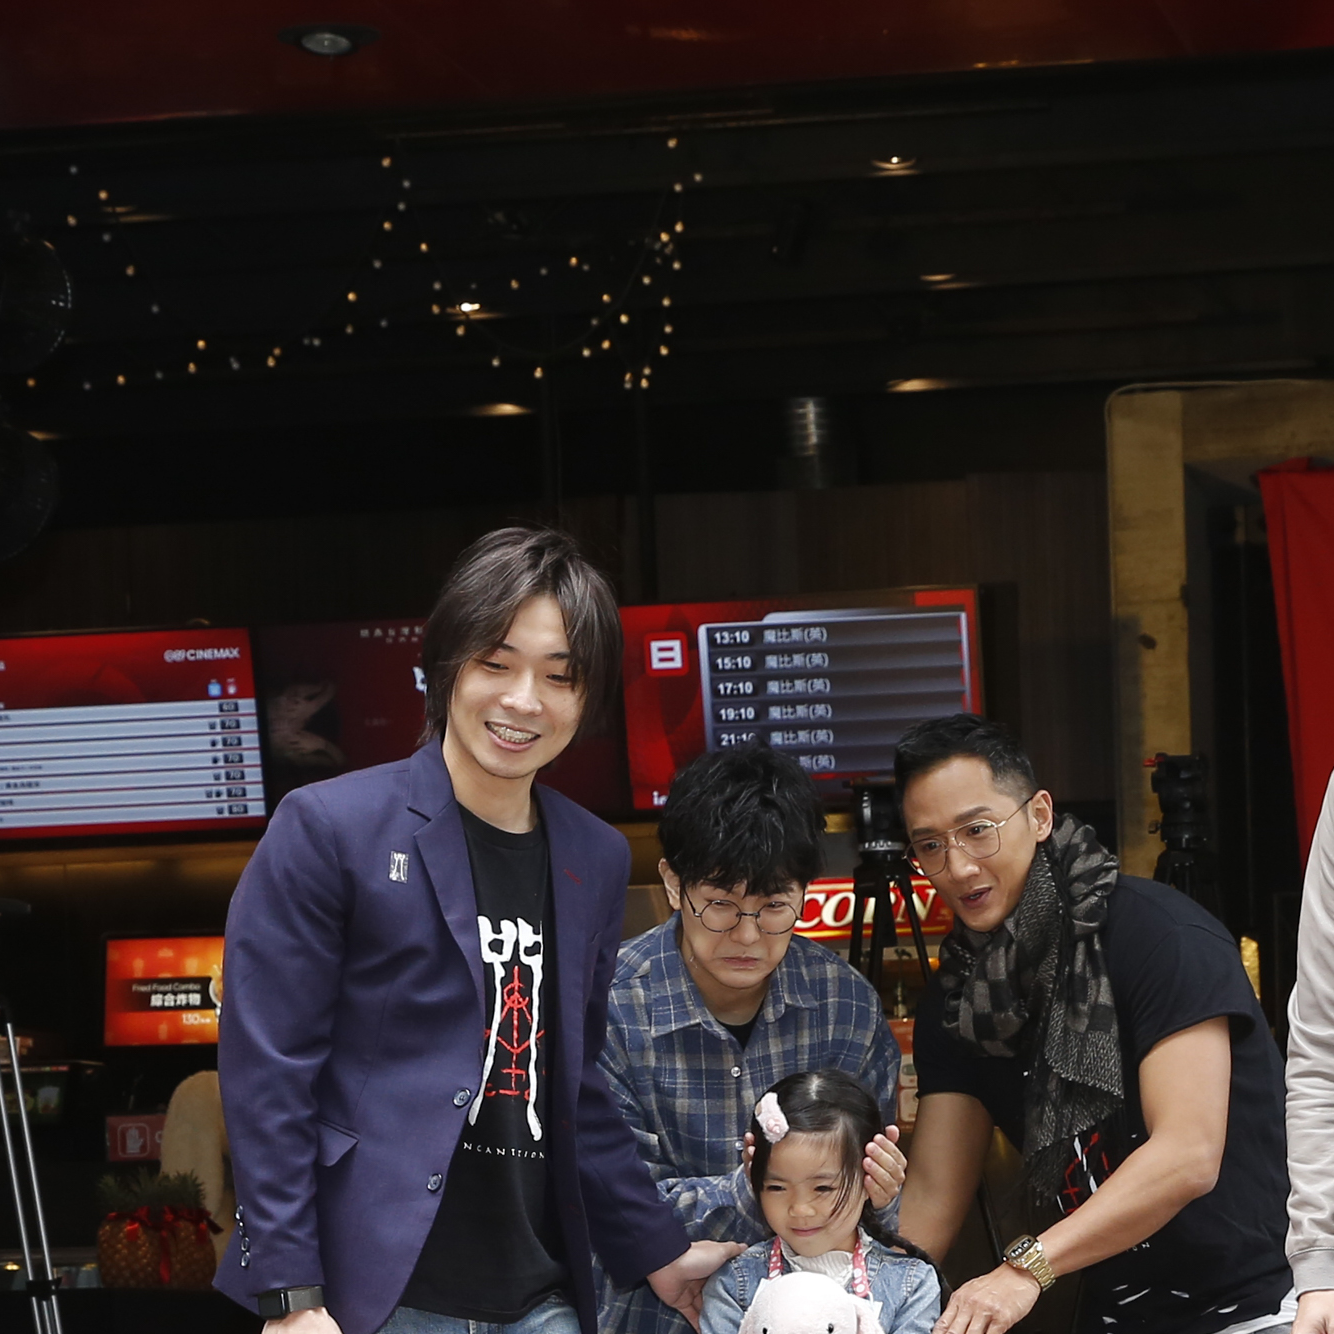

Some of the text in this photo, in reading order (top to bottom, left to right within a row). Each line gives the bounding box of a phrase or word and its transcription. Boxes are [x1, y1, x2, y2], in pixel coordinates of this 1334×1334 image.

[714, 630, 750, 644] 13:10
[186, 647, 241, 661] CINEMAX
[716, 656, 752, 670] 15:10
[717, 682, 754, 695] 17:10
[719, 707, 755, 721] 19:10
[173, 981, 201, 991] Combo
